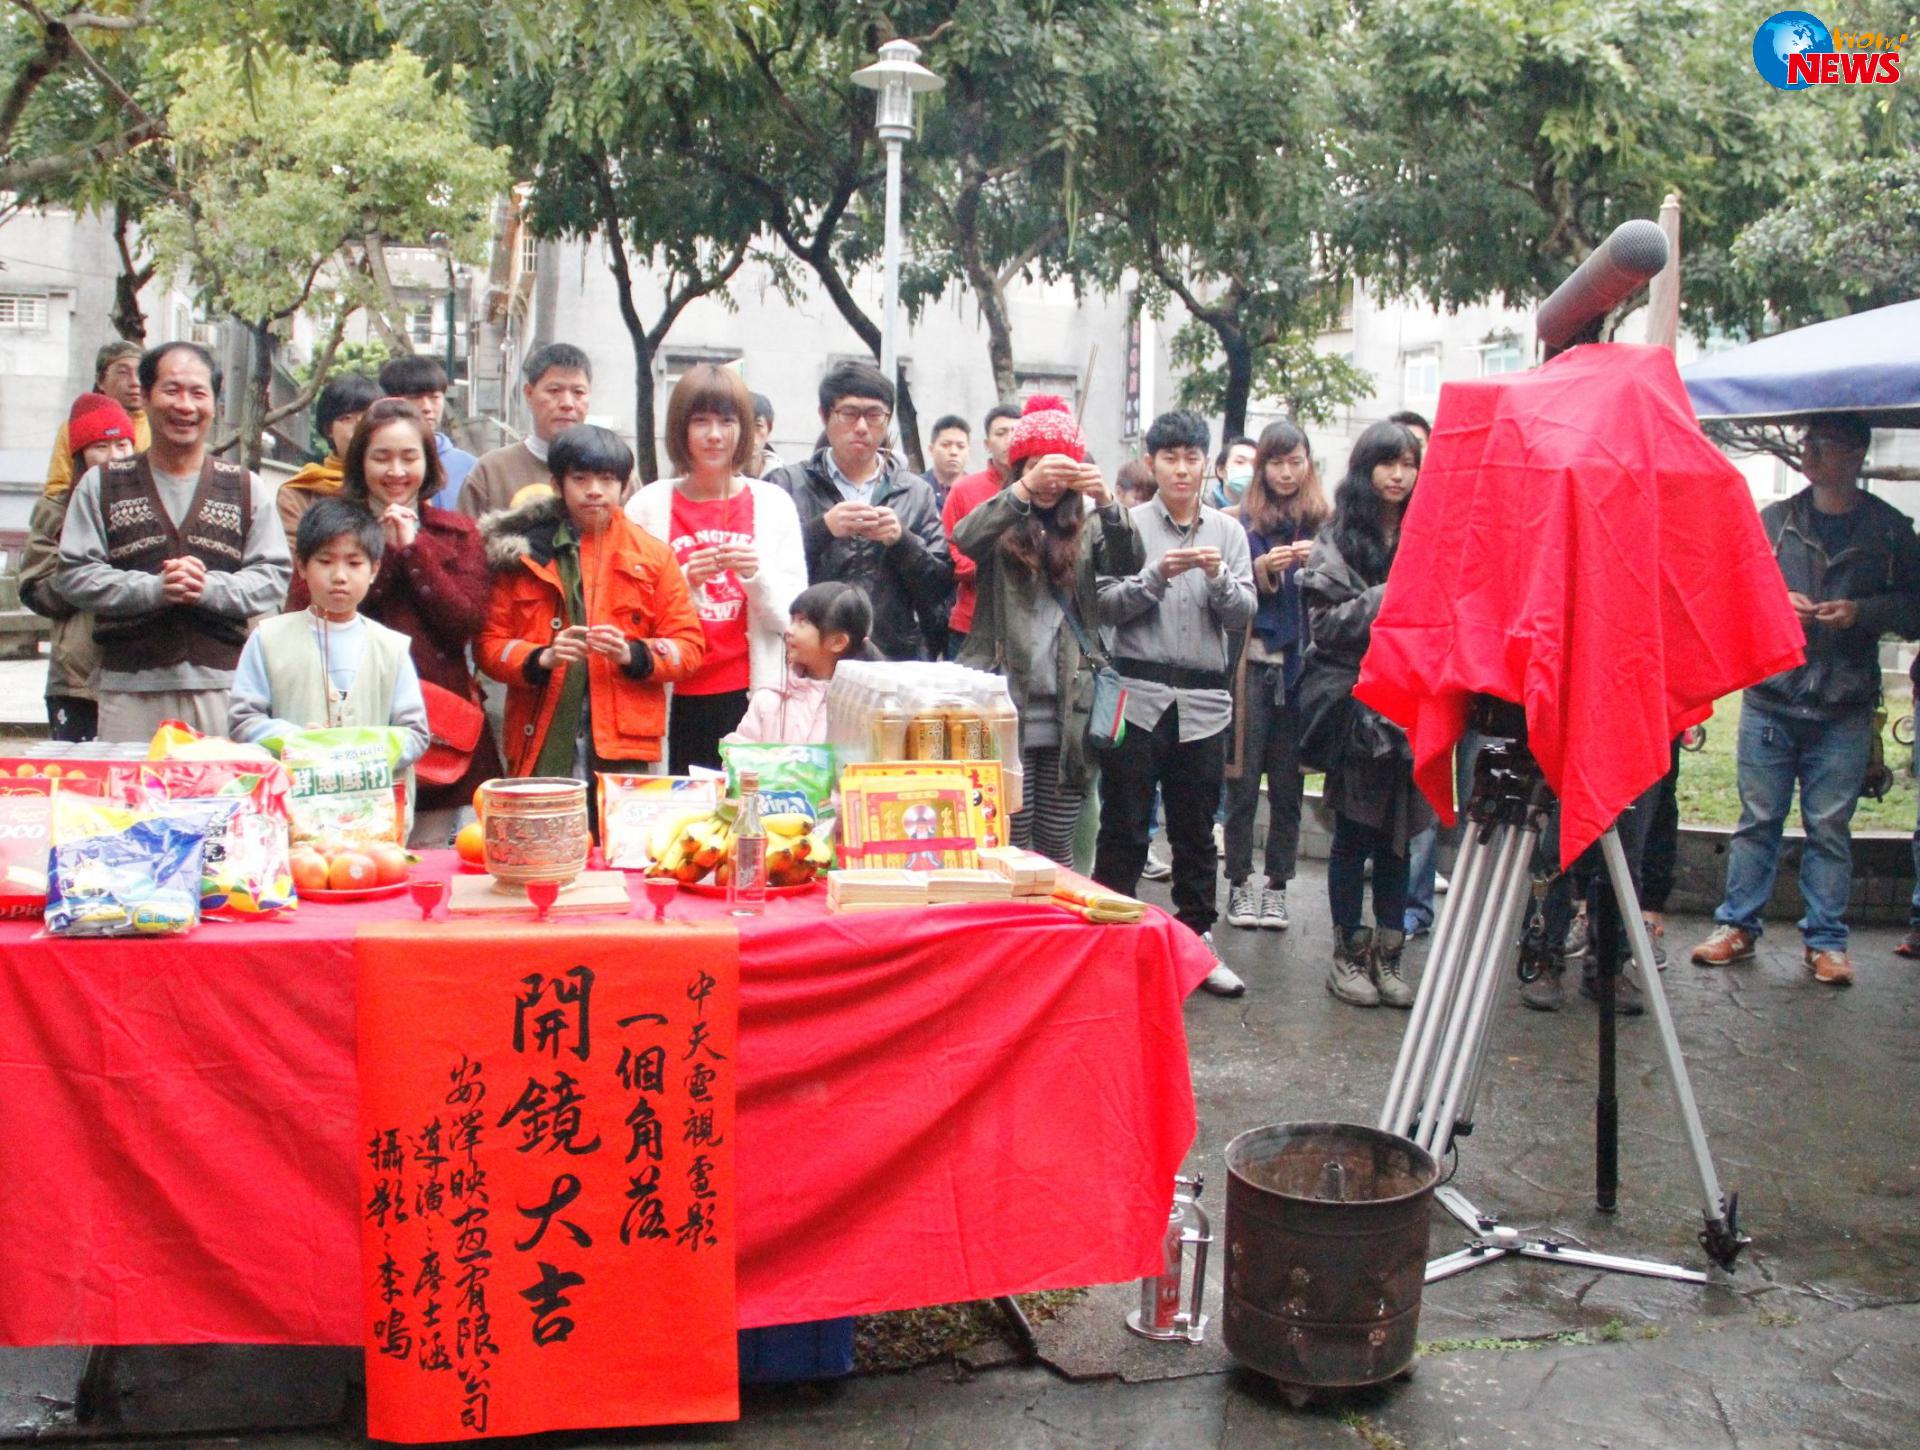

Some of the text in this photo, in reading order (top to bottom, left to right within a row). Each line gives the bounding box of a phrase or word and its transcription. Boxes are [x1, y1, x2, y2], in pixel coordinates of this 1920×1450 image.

[497, 965, 602, 1348] 開鏡大吉
[615, 1012, 671, 1246] 一個角落
